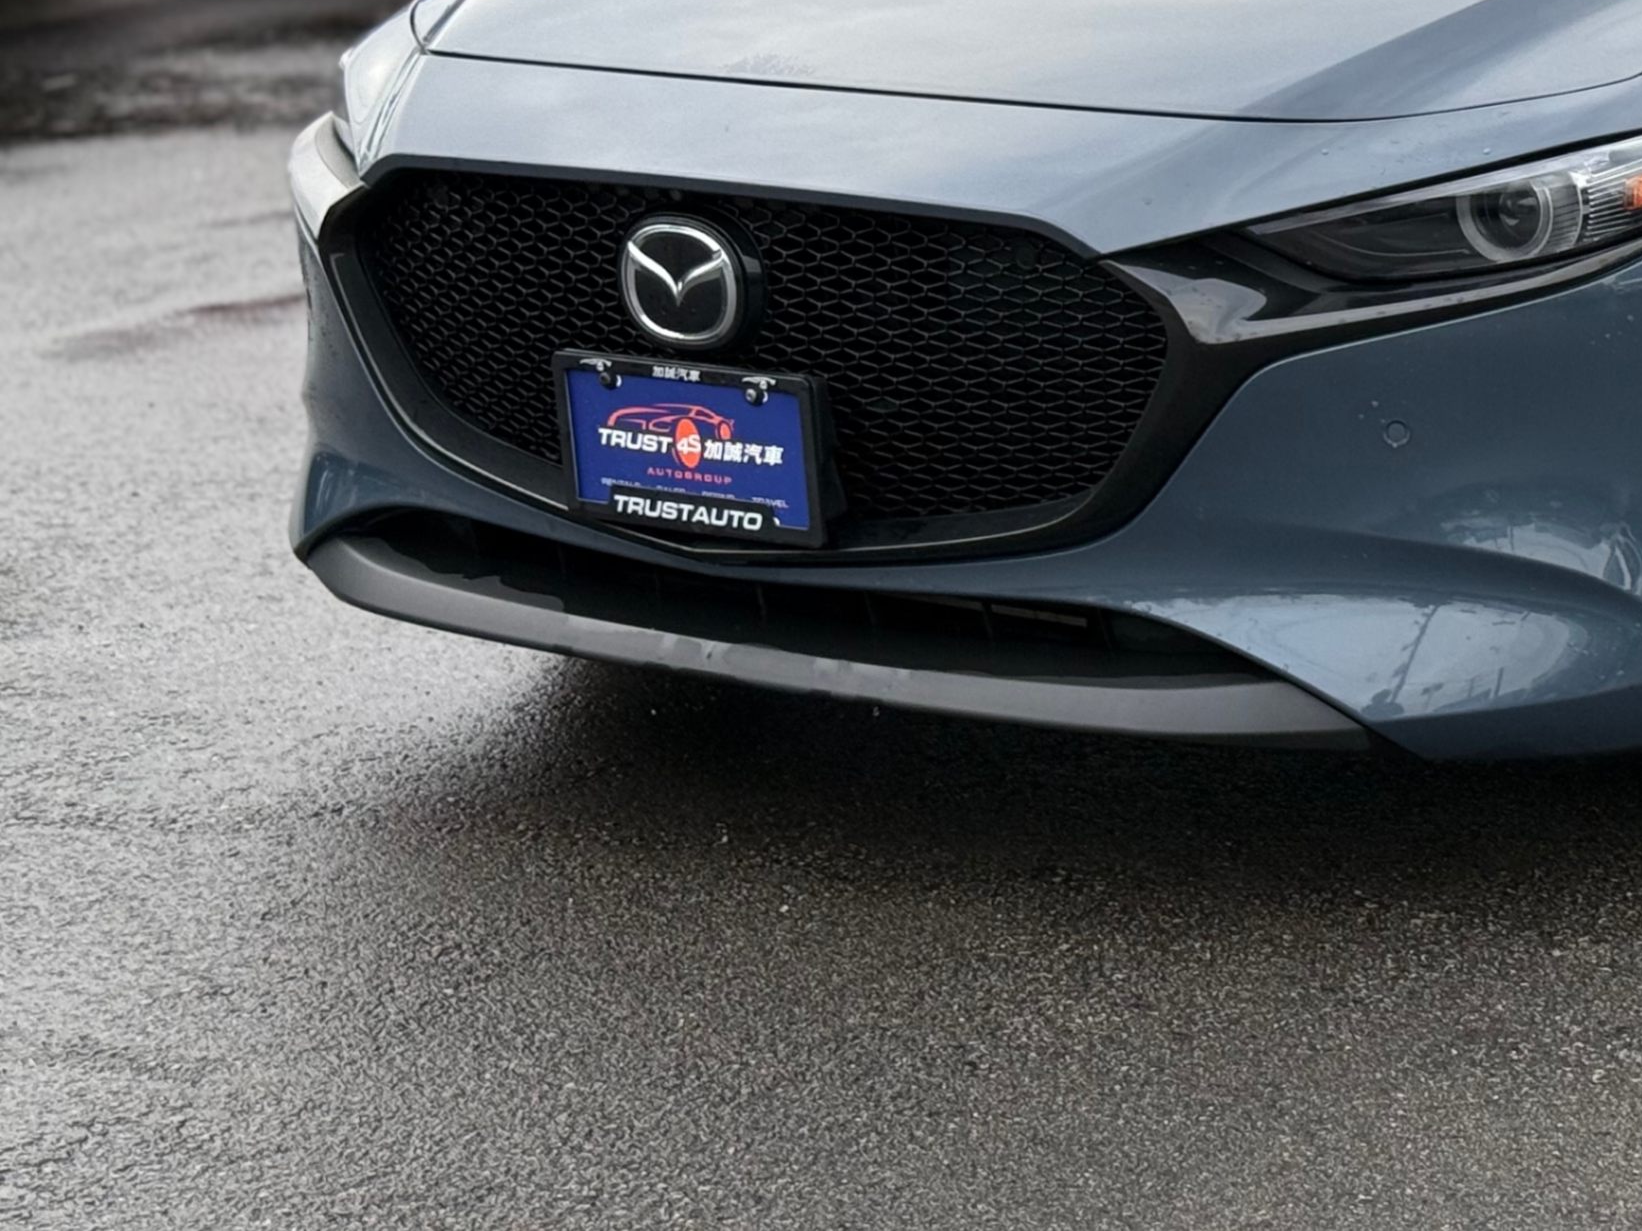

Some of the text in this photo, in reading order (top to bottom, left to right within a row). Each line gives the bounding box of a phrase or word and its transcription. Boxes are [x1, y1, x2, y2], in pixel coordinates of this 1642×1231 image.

[598, 427, 784, 466] TRUST 4S 加誠汽車
[647, 467, 732, 485] AUTOGROUP
[614, 494, 763, 531] TRUSTAUTO
